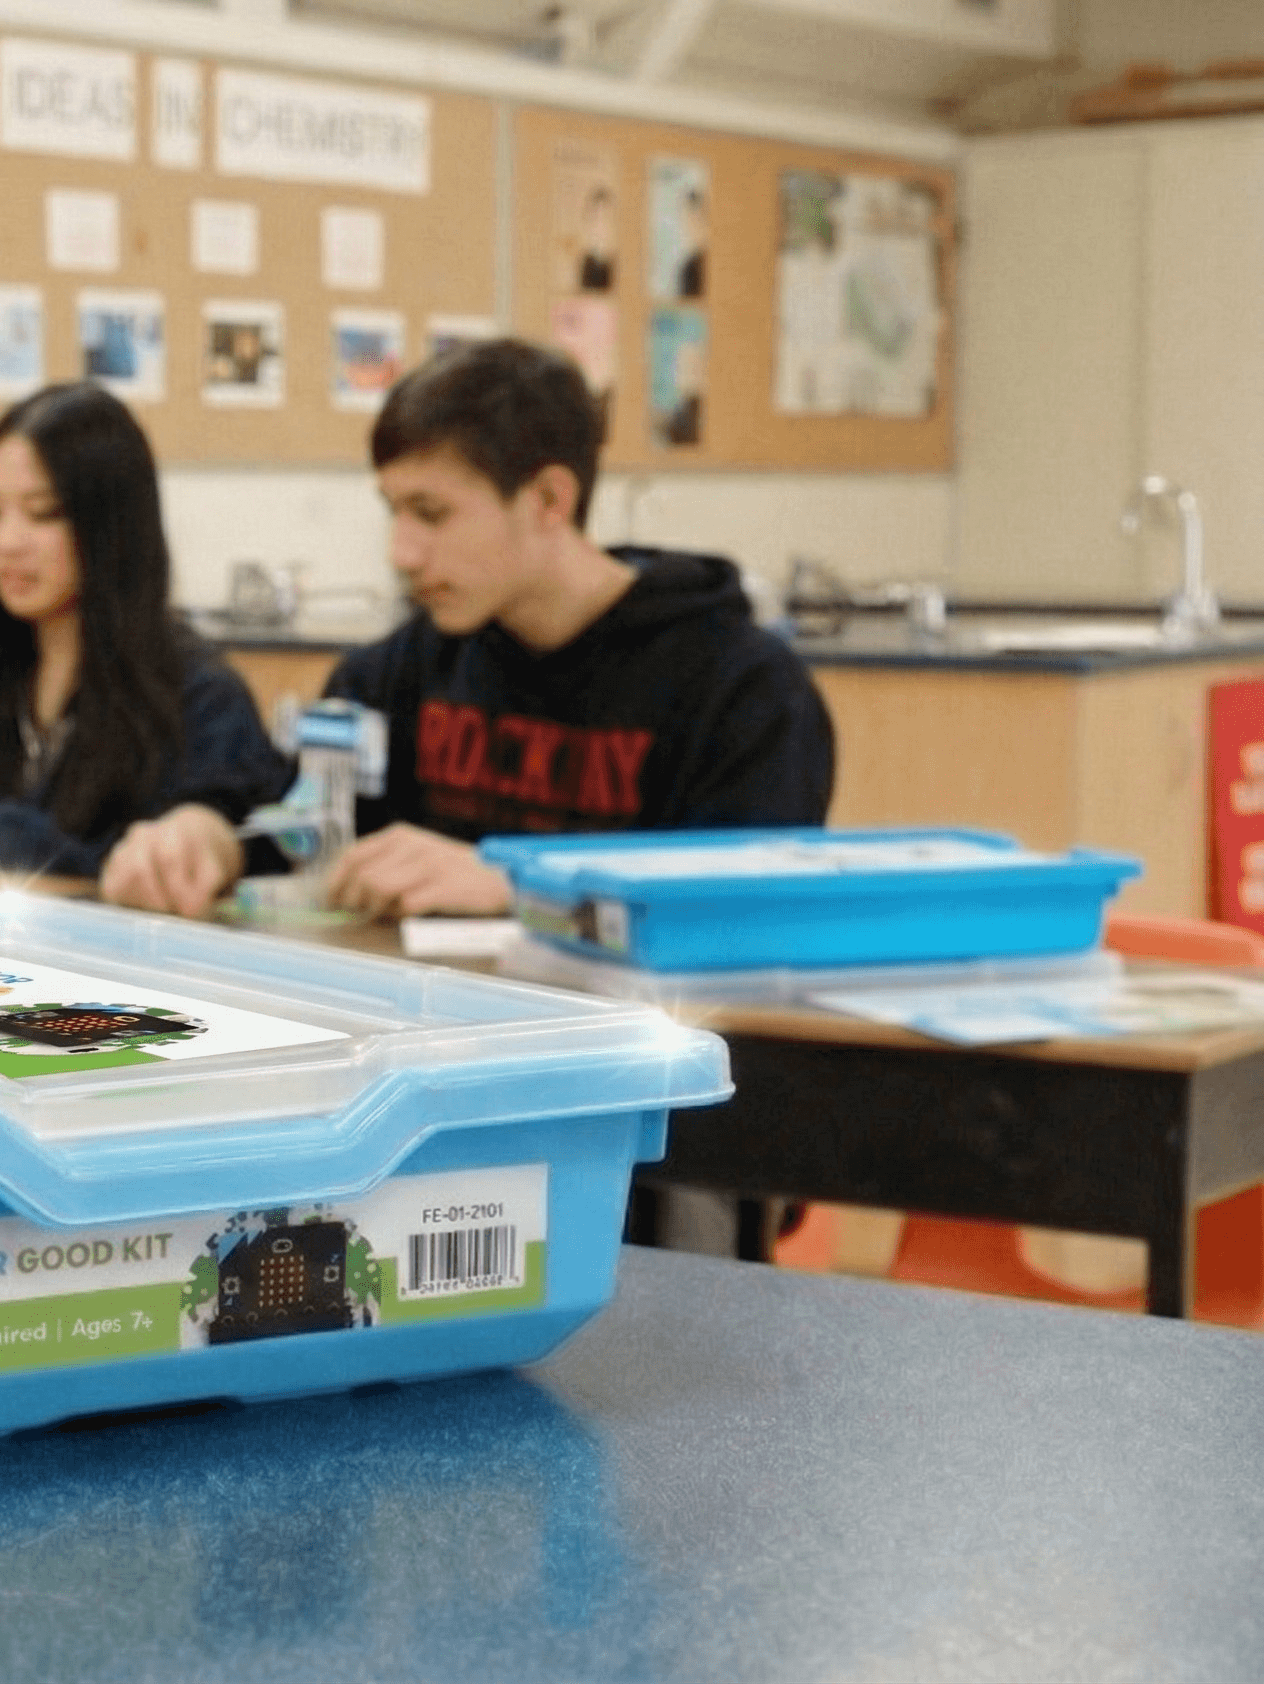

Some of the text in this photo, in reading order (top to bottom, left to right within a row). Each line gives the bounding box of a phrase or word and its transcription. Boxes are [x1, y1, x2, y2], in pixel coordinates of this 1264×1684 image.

[12, 66, 136, 129] IDEAS
[422, 1202, 504, 1224] FE-01-2101
[16, 1240, 114, 1274] GOOD
[122, 1232, 174, 1263] KIT
[71, 1314, 123, 1340] Ages
[130, 1310, 153, 1332] 7+
